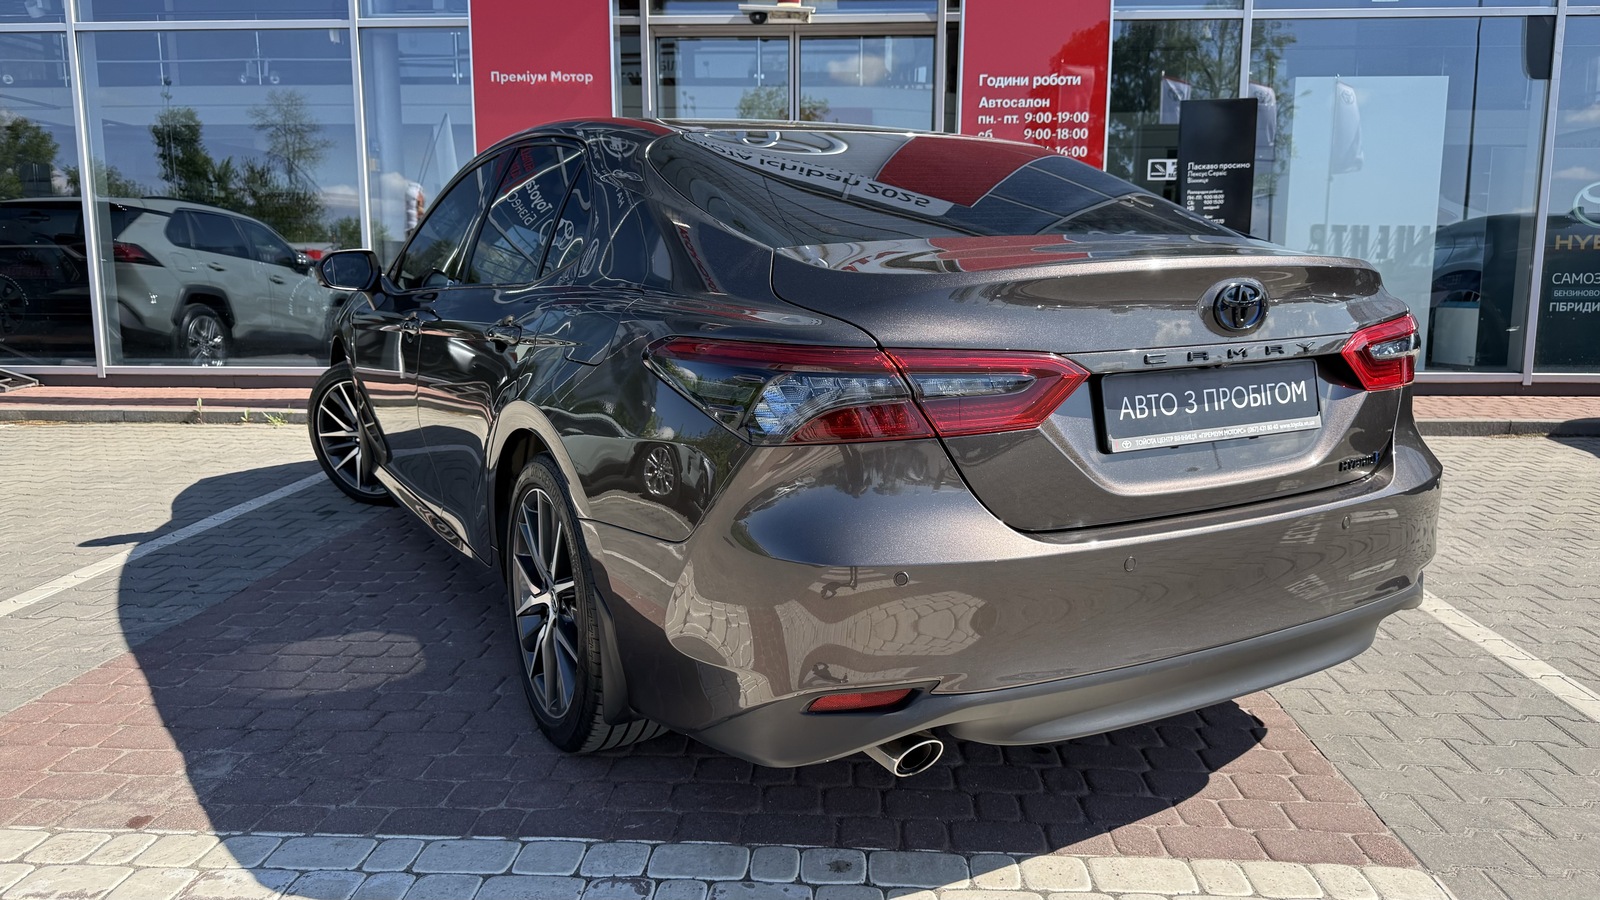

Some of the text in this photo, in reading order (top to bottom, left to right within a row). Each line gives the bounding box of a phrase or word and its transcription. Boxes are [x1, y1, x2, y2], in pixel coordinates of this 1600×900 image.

[490, 71, 594, 85] Преміум Мотор
[979, 74, 1082, 89] Години роботи
[978, 97, 1050, 108] Автосалон
[1024, 112, 1090, 124] 9:00-19:00
[1023, 128, 1089, 140] 9:00-18:00
[1219, 162, 1251, 171] просимо
[1143, 341, 1317, 366] CAMRY
[1119, 392, 1178, 421] АВТО
[1203, 380, 1308, 412] ПРОБІГОМ
